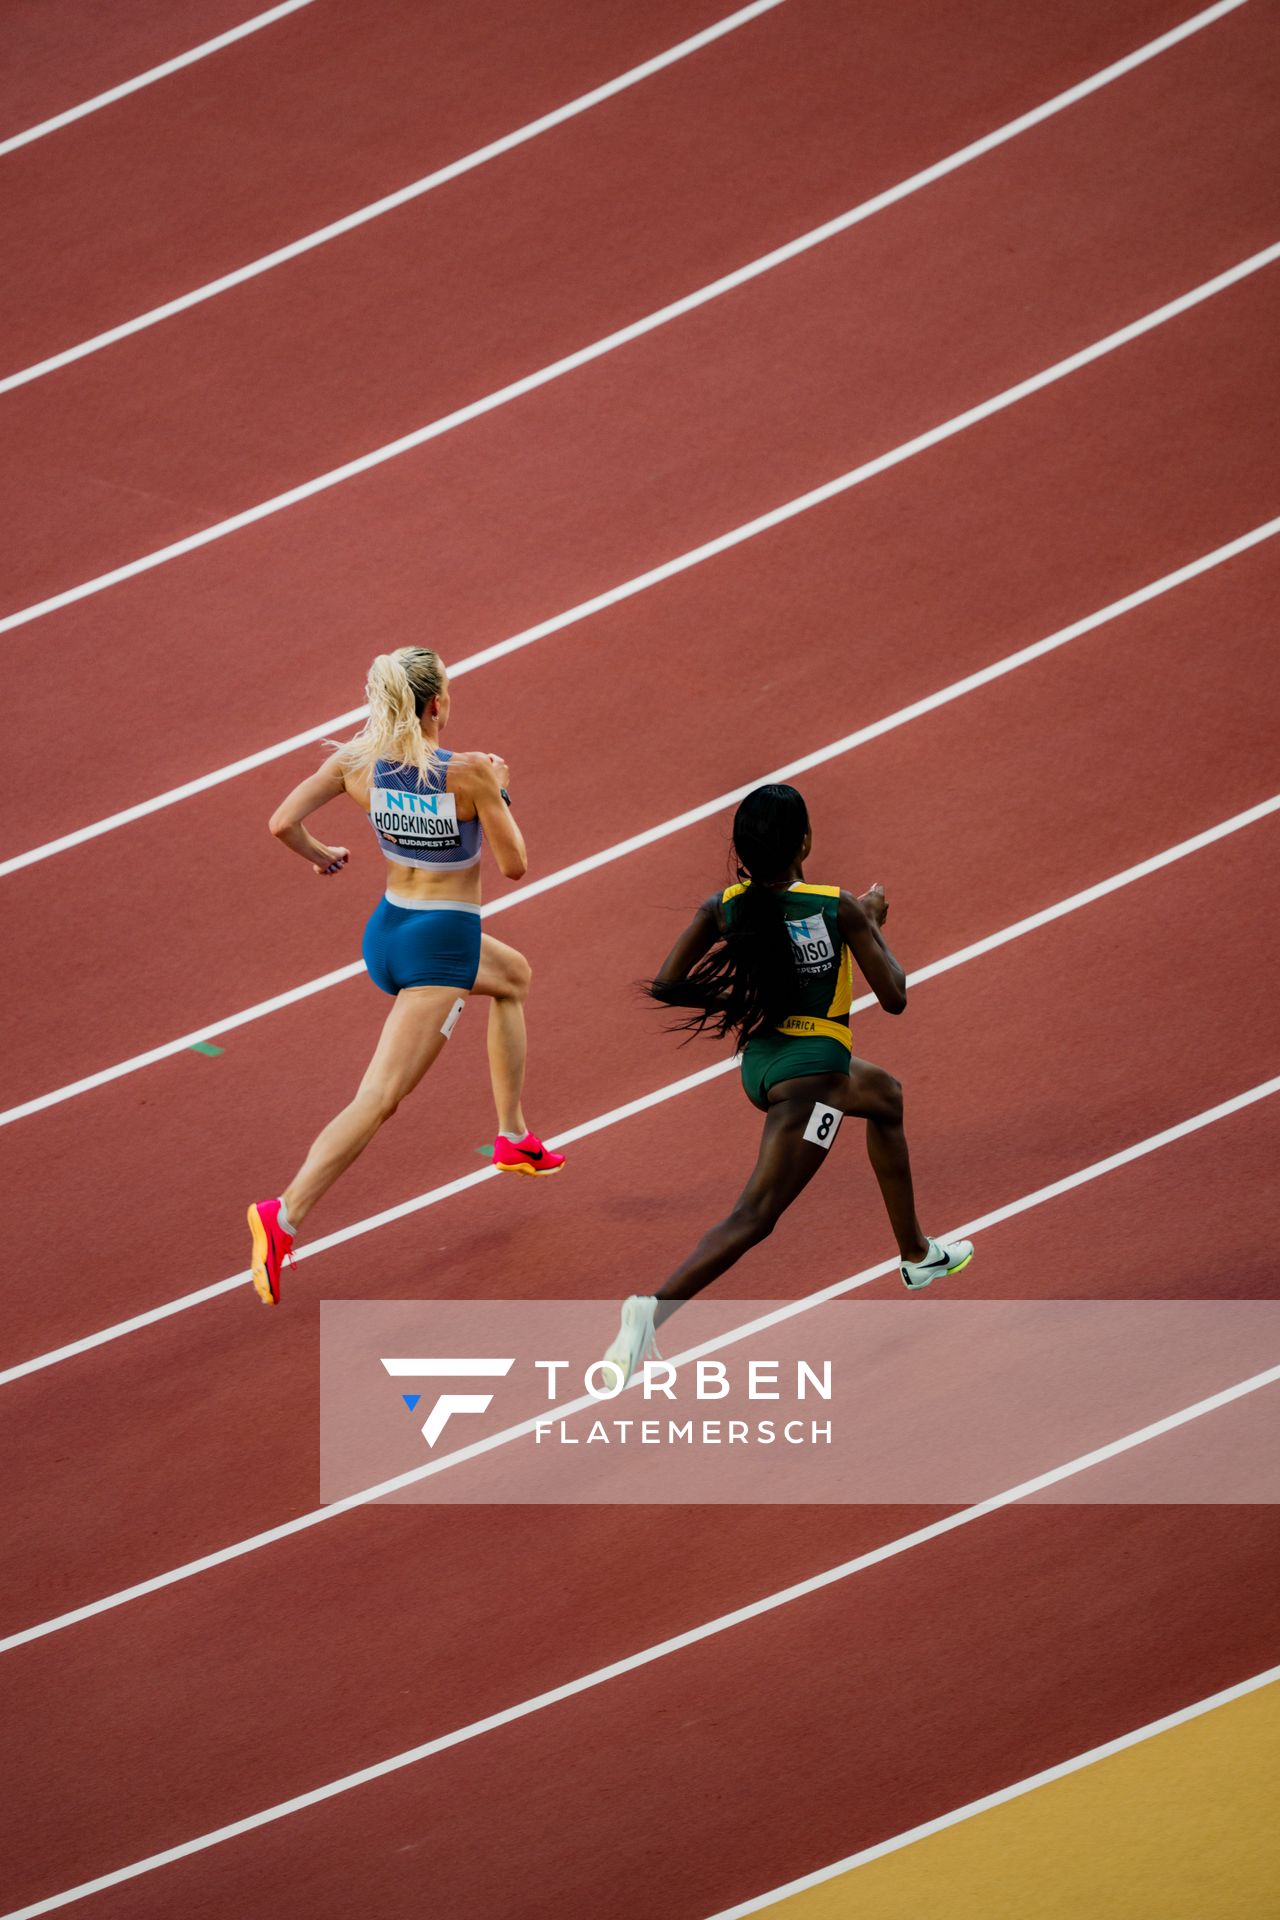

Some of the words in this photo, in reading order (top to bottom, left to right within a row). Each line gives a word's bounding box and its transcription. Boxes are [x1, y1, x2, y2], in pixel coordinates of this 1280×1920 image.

[386, 791, 438, 816] NTN
[375, 812, 454, 835] HODGKINSON
[399, 838, 443, 848] BUDAPEST
[786, 1019, 815, 1031] AFRICA
[817, 1113, 834, 1140] 8
